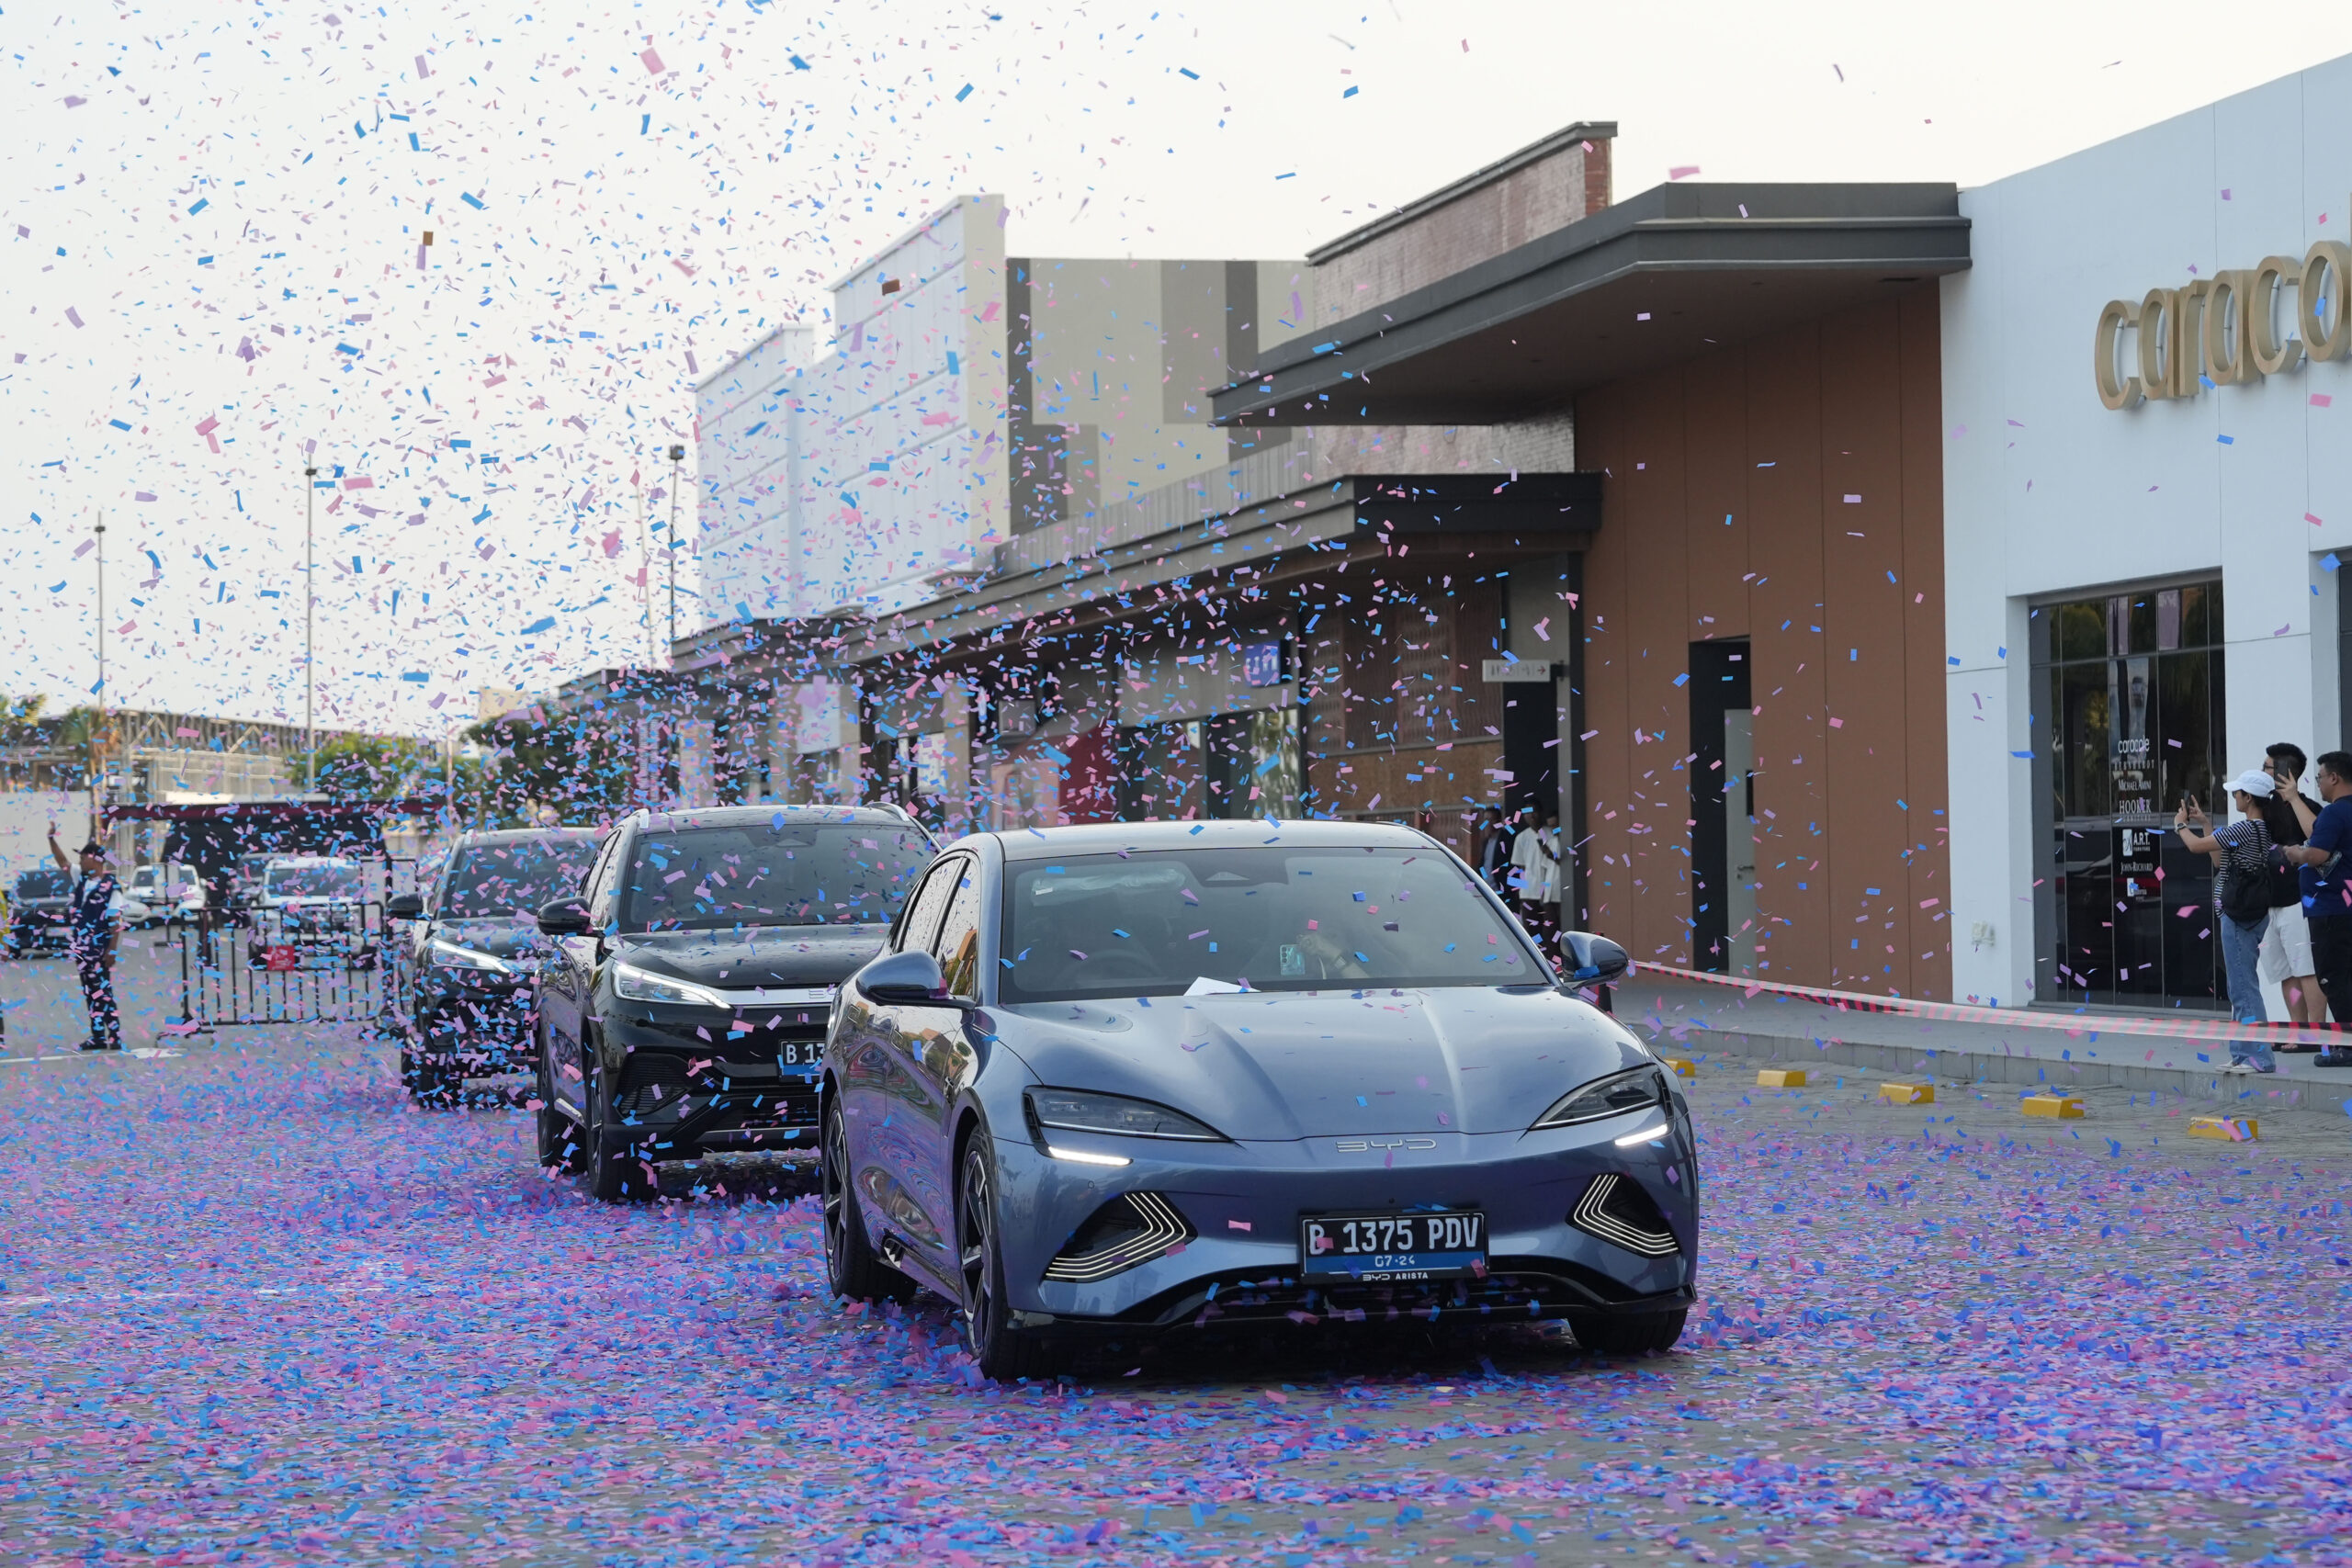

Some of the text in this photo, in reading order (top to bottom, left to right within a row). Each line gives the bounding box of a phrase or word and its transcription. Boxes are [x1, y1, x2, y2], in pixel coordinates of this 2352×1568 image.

[2095, 193, 2352, 411] caraco
[2133, 831, 2151, 846] A.R.T.
[786, 1043, 797, 1064] B
[1336, 1138, 1437, 1153] BYD
[1309, 1217, 1478, 1255] B 1375 PDV
[1396, 1272, 1429, 1280] ARISTA
